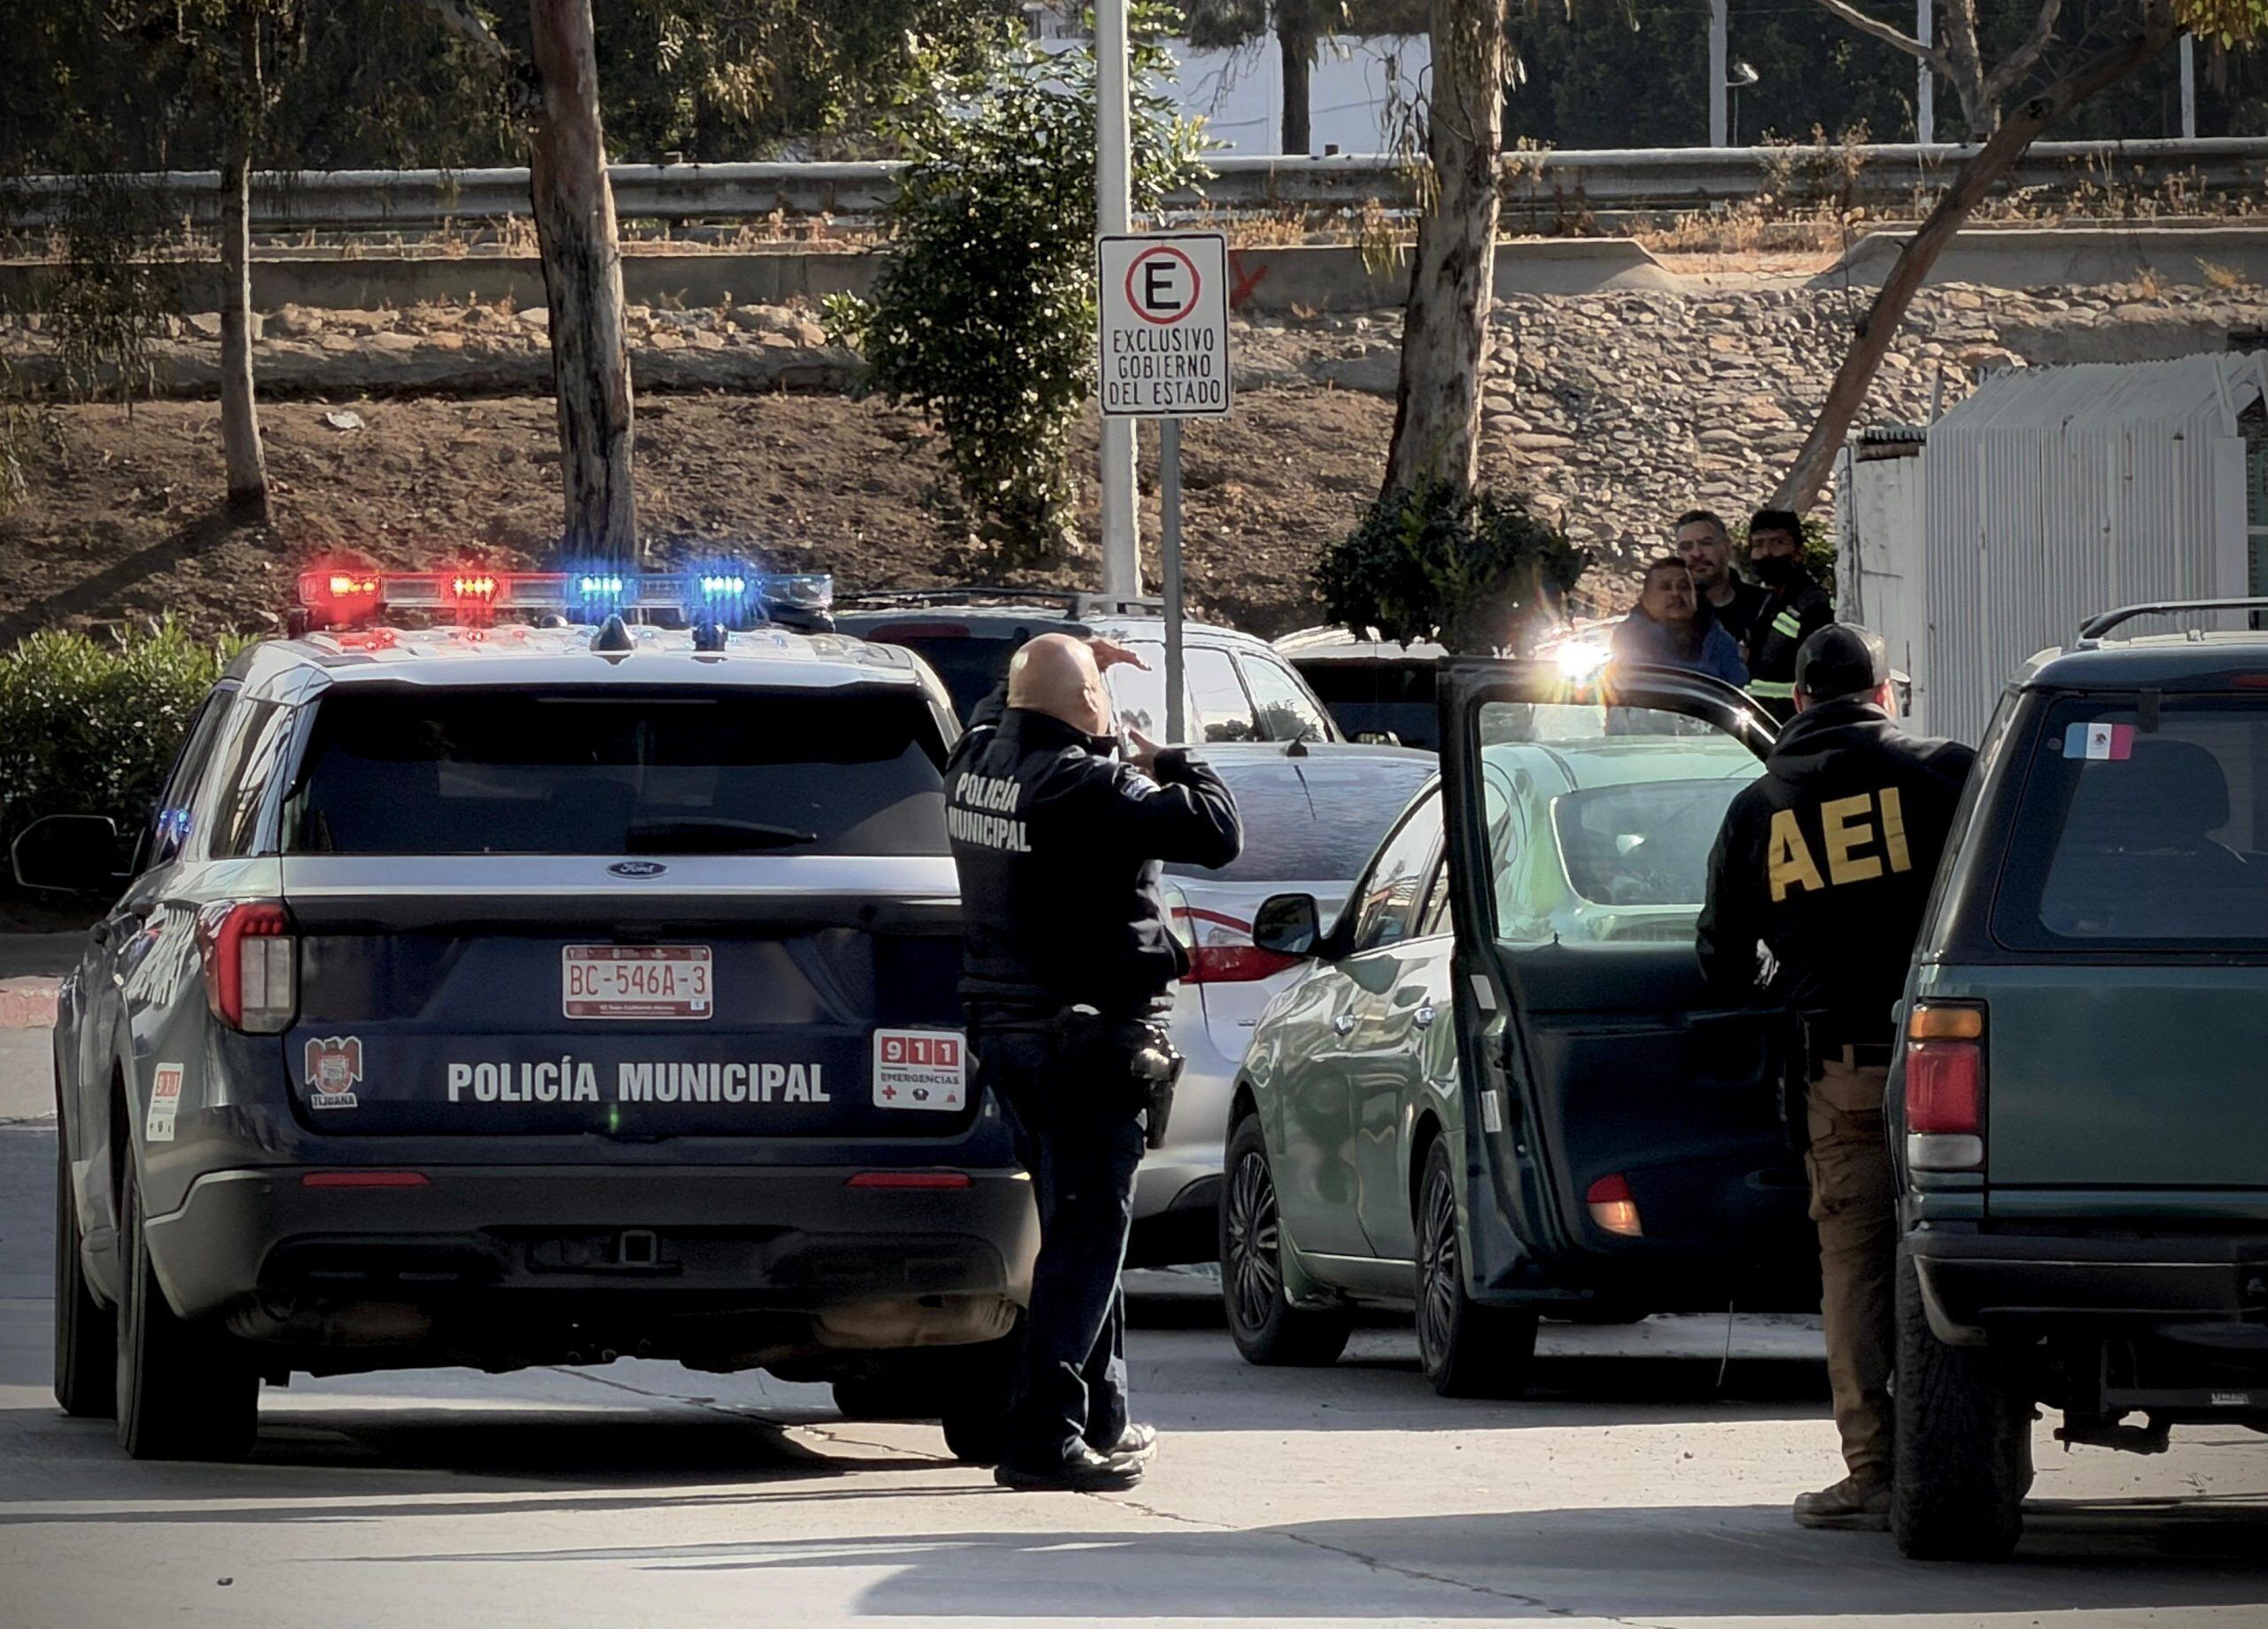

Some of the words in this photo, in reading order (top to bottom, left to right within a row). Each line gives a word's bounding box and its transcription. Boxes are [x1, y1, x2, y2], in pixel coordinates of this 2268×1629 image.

[1145, 261, 1181, 310] E
[1113, 328, 1215, 353] EXCLUSIVO
[1117, 354, 1211, 379] GOBIERNO
[1109, 381, 1143, 406] DEL
[1153, 379, 1221, 406] ESTADO
[955, 772, 1021, 813] POLICÍA
[948, 804, 1032, 853] MUNICIPAL
[1767, 786, 1913, 903] AEI
[570, 965, 706, 996] BC-546A-3
[886, 1040, 951, 1063] 911
[447, 1055, 601, 1103] POLICÍA
[618, 1063, 831, 1103] MUNICIPAL
[880, 1073, 960, 1085] EMERGENCIAS
